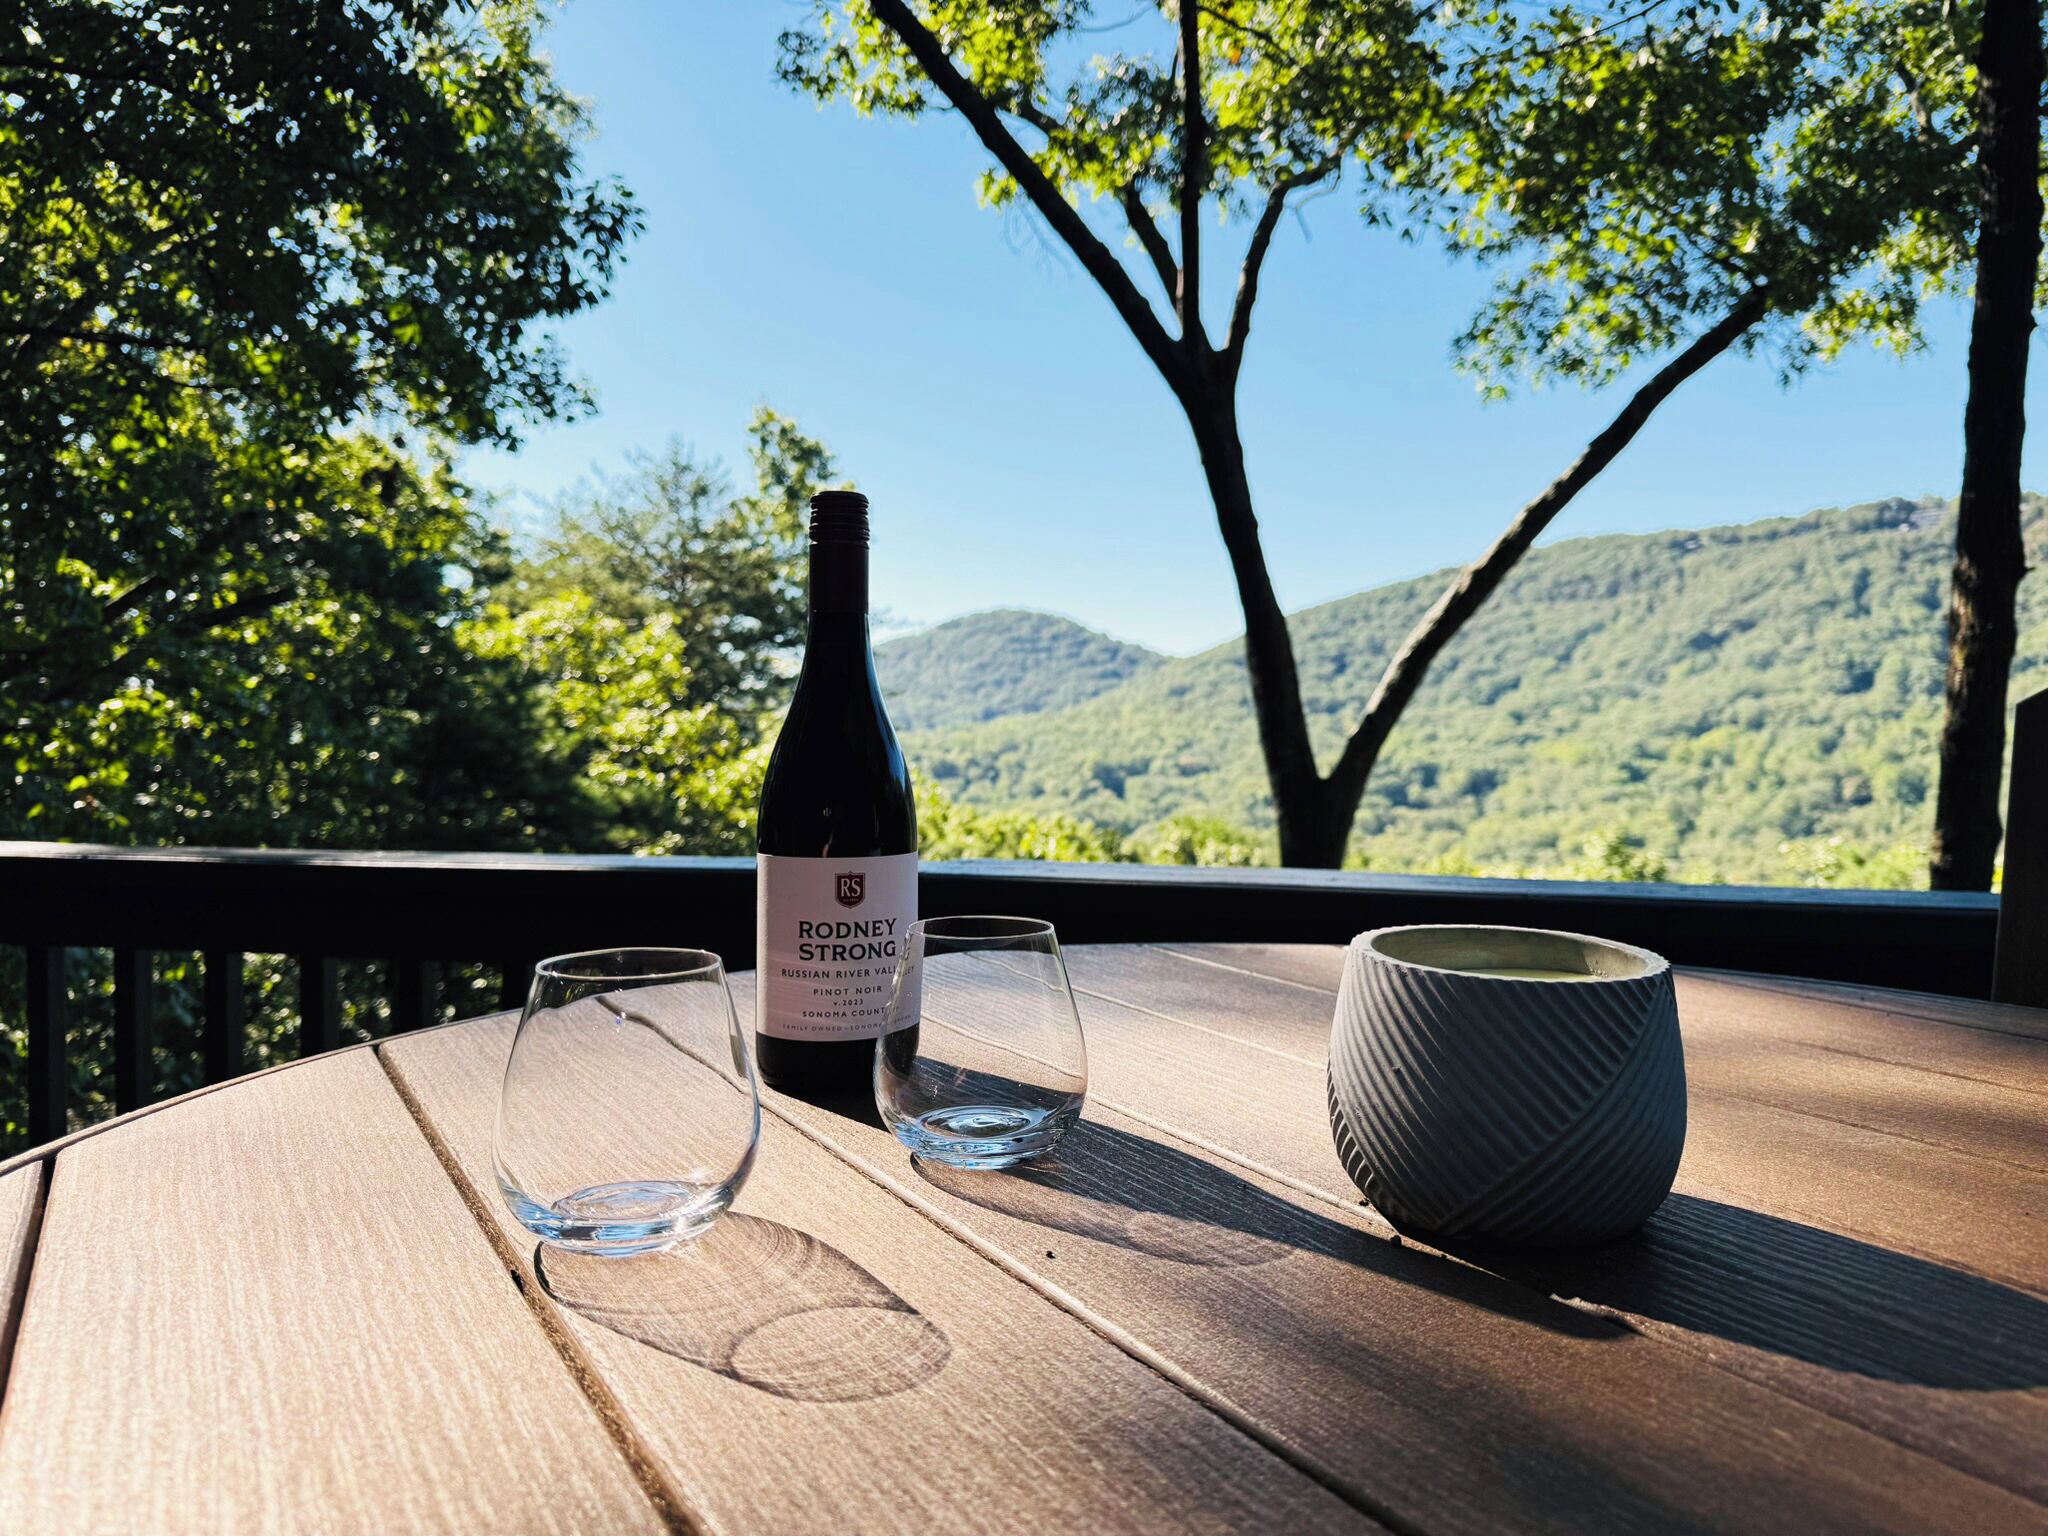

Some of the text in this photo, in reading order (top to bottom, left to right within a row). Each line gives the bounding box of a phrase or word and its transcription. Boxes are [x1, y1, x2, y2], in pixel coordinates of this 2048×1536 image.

[841, 878, 861, 897] RS
[799, 918, 896, 939] RODNEY
[799, 941, 896, 961] STRONG
[782, 969, 829, 979] RUSSIAN
[836, 969, 870, 978] RIVER
[813, 986, 882, 996] PINOT NOIR
[803, 1010, 847, 1018] SONOMA
